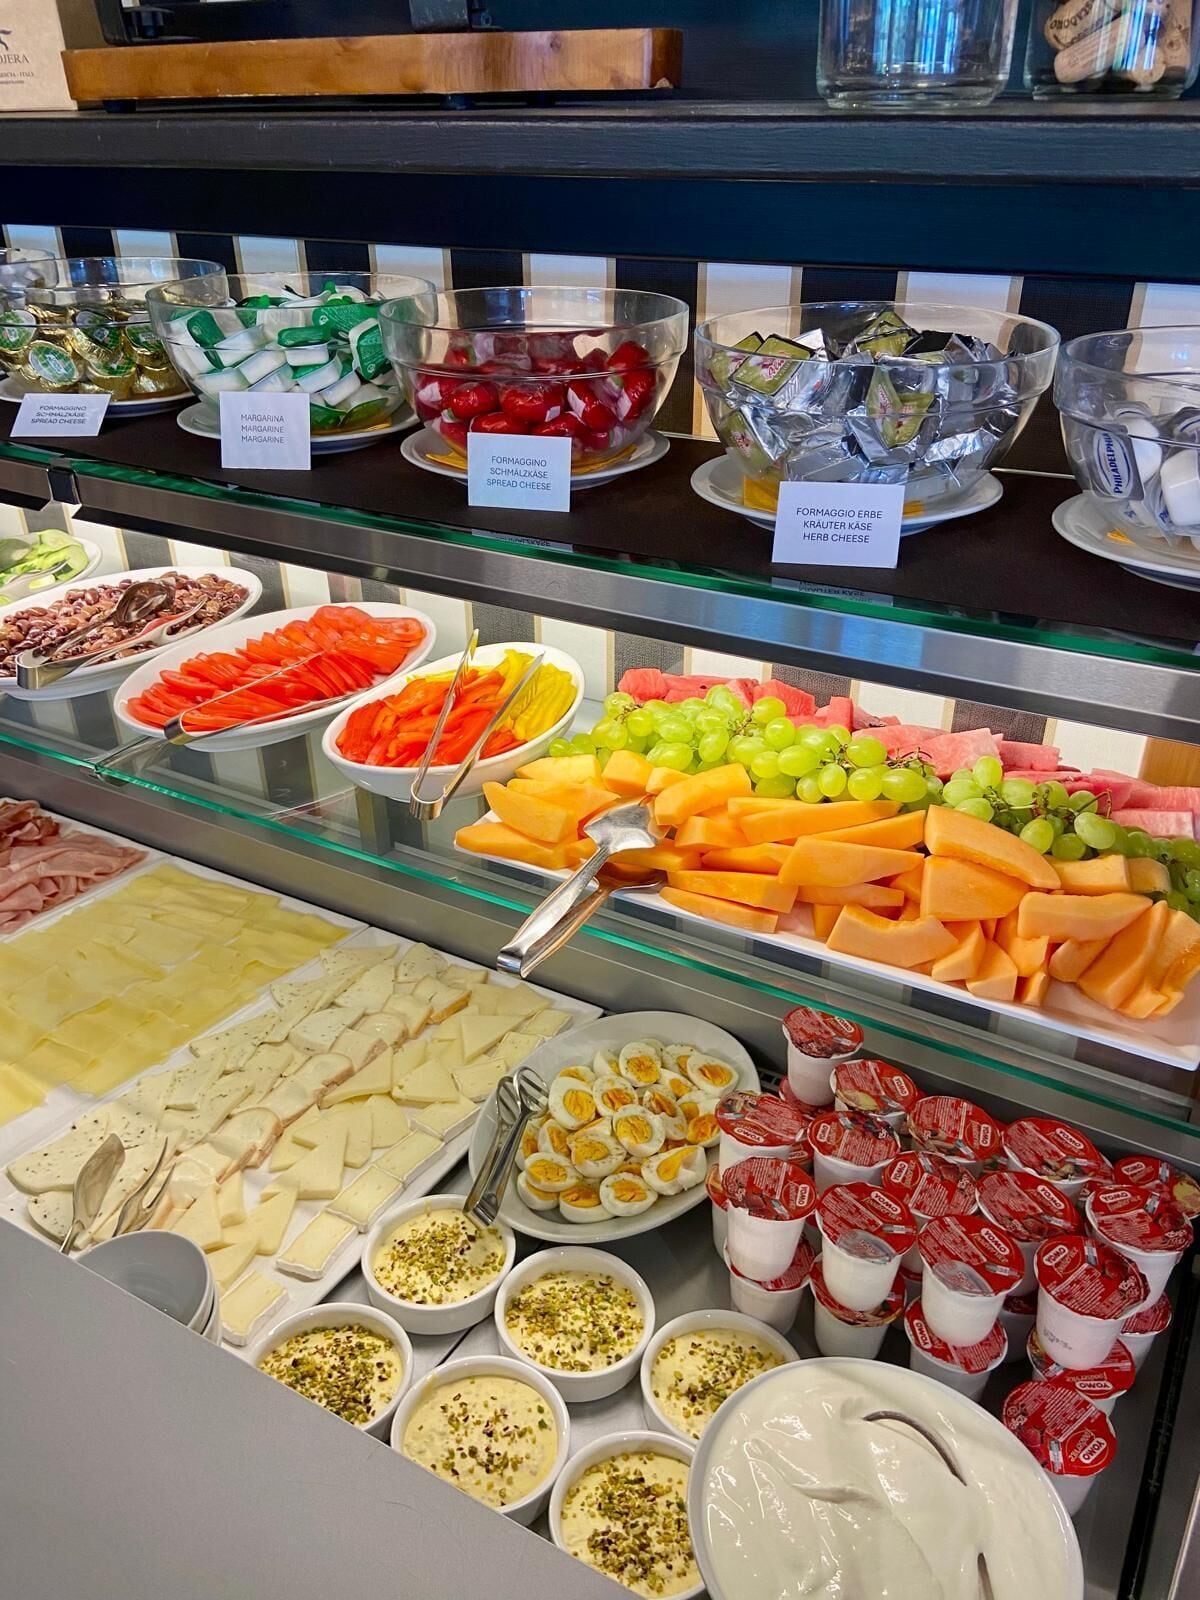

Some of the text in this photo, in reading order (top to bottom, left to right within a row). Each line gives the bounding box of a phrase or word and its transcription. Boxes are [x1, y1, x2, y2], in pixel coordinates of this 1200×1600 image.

[240, 414, 285, 422] MARGARINA
[241, 424, 285, 433] MARGARINE
[241, 435, 285, 444] MARGARINE
[491, 455, 547, 468] FORMAGGINO
[1101, 432, 1123, 494] PHILADELPHIA
[486, 478, 551, 491] SPREAD CHEESE
[796, 507, 883, 519] FORMAGGIO ERBE
[803, 519, 872, 531] KRÄUTER KÄSE
[803, 532, 870, 544] HERB CHEESE
[736, 1127, 761, 1142] YOMO
[982, 1125, 990, 1145] YOMO
[1059, 1130, 1081, 1148] YOMO
[893, 1162, 906, 1182] YOMO
[799, 1186, 808, 1205] YOMO
[874, 1192, 899, 1213] YOMO
[1040, 1187, 1062, 1208] YOMO
[1102, 1191, 1129, 1201] YOMO
[984, 1230, 1007, 1253] YOMO
[1044, 1246, 1067, 1263] YOMO
[915, 1322, 929, 1346] YOMO
[1078, 1381, 1111, 1389] YOMO
[1082, 1439, 1105, 1461] YOMO
